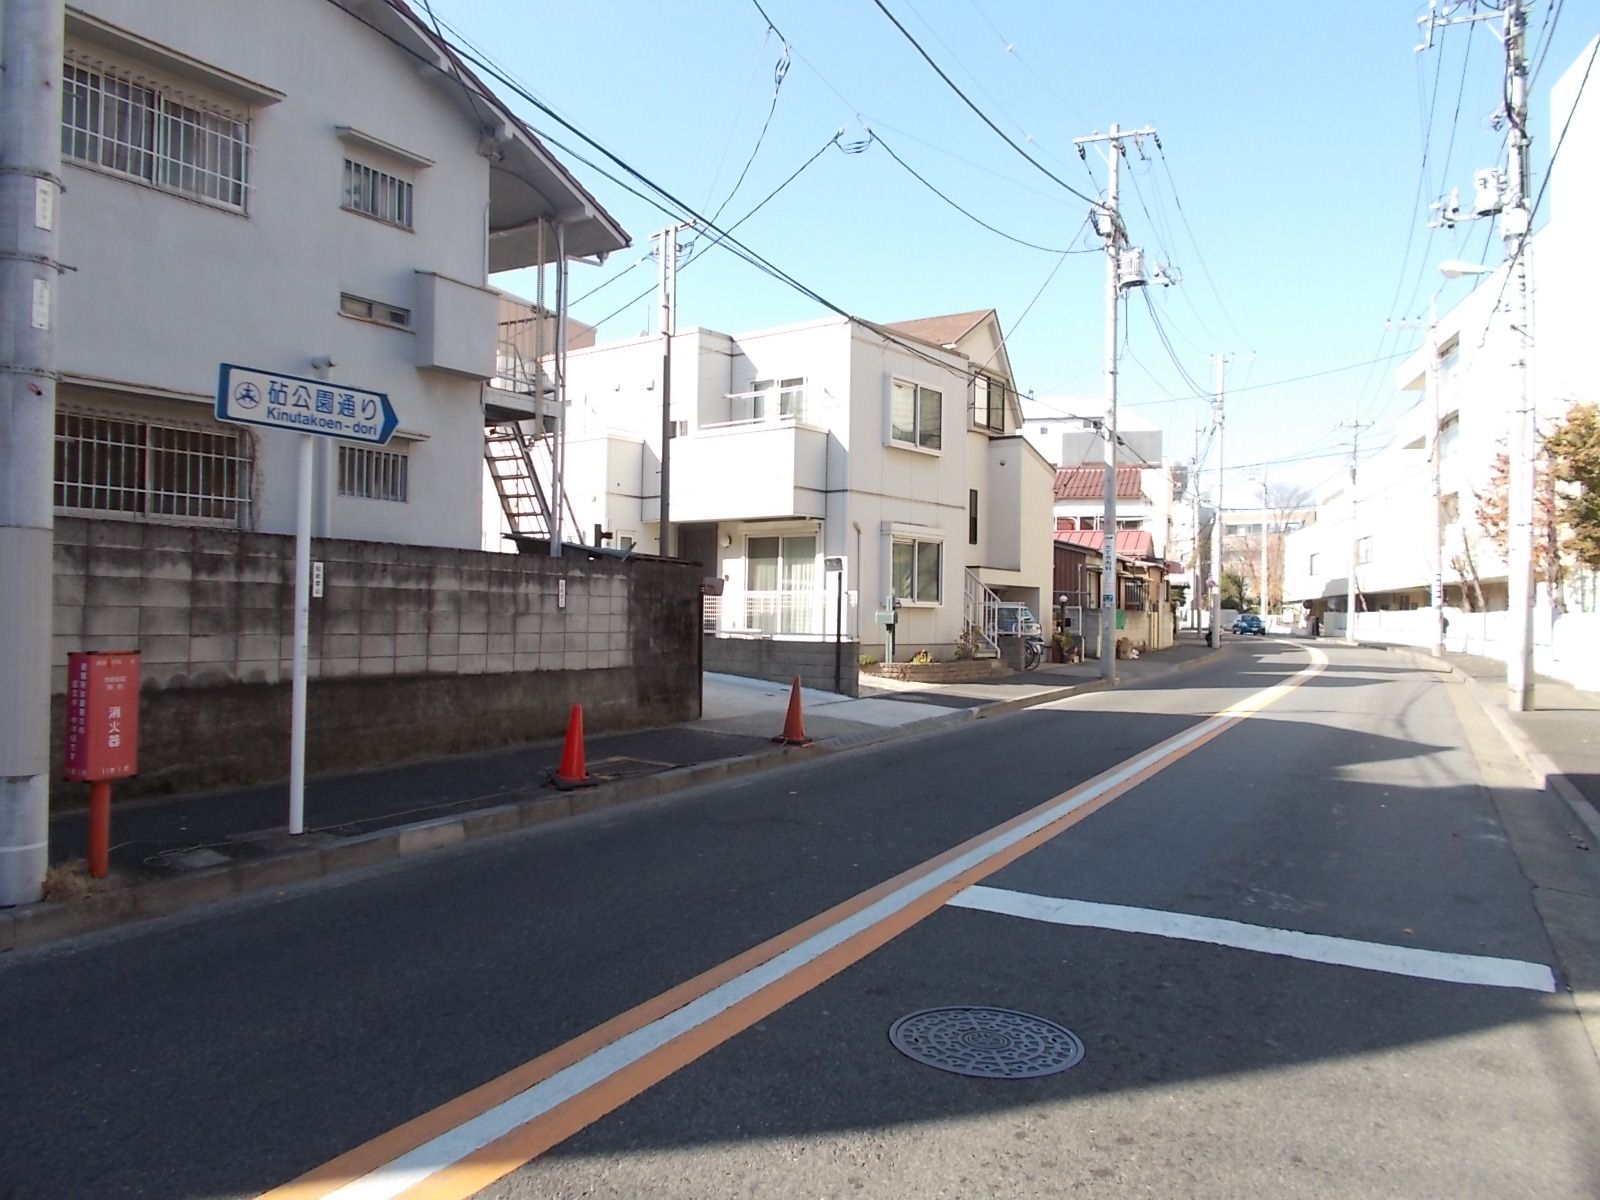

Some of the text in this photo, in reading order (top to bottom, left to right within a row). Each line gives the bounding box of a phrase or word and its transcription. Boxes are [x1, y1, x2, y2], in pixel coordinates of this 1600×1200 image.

[267, 380, 377, 421] 砧公園通り
[108, 705, 121, 748] 消火器
